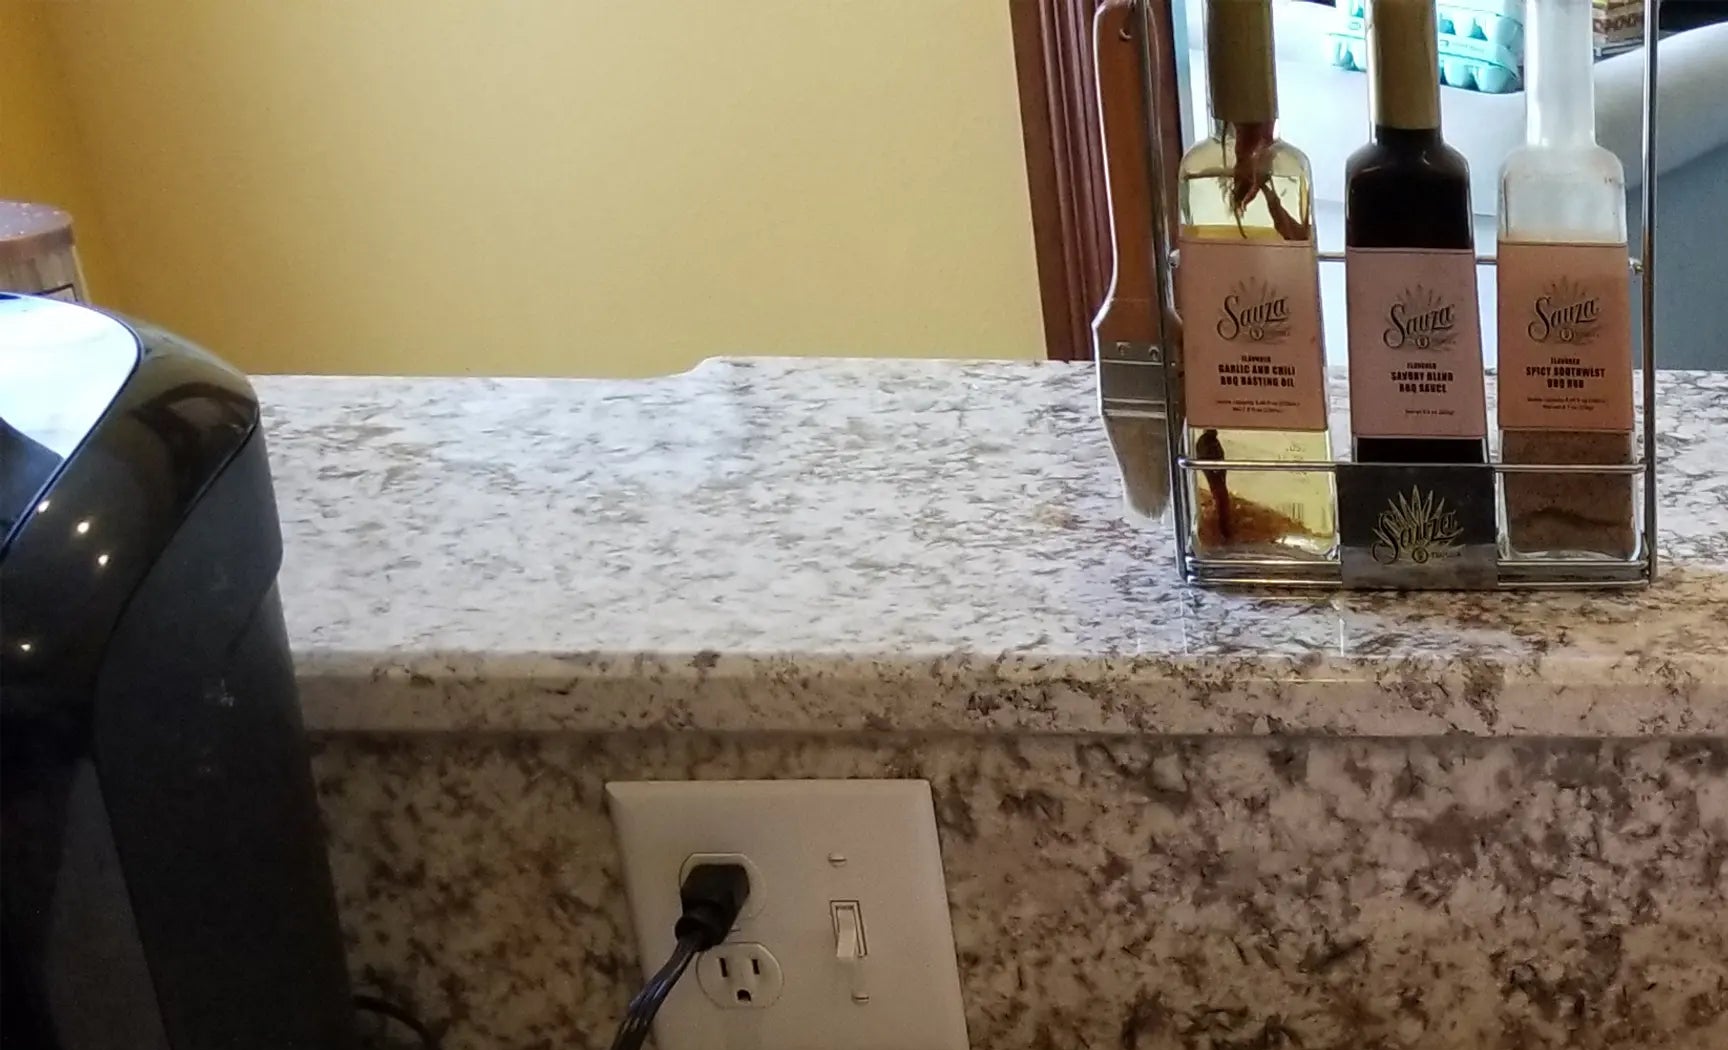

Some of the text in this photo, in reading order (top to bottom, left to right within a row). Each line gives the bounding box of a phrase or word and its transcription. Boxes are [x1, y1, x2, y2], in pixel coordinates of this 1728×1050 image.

[1217, 294, 1288, 340] Sauza
[1528, 297, 1600, 343] Sauza
[1383, 303, 1455, 349] Sauza
[1218, 364, 1295, 375] GARLIC AND CHILI
[1526, 366, 1606, 378] SPICY SOUTHWEST
[1220, 376, 1295, 387] BBQ BASTING OIL
[1390, 371, 1424, 381] SAVORY
[1418, 383, 1447, 393] SAUCE
[1372, 510, 1464, 565] Sauza
